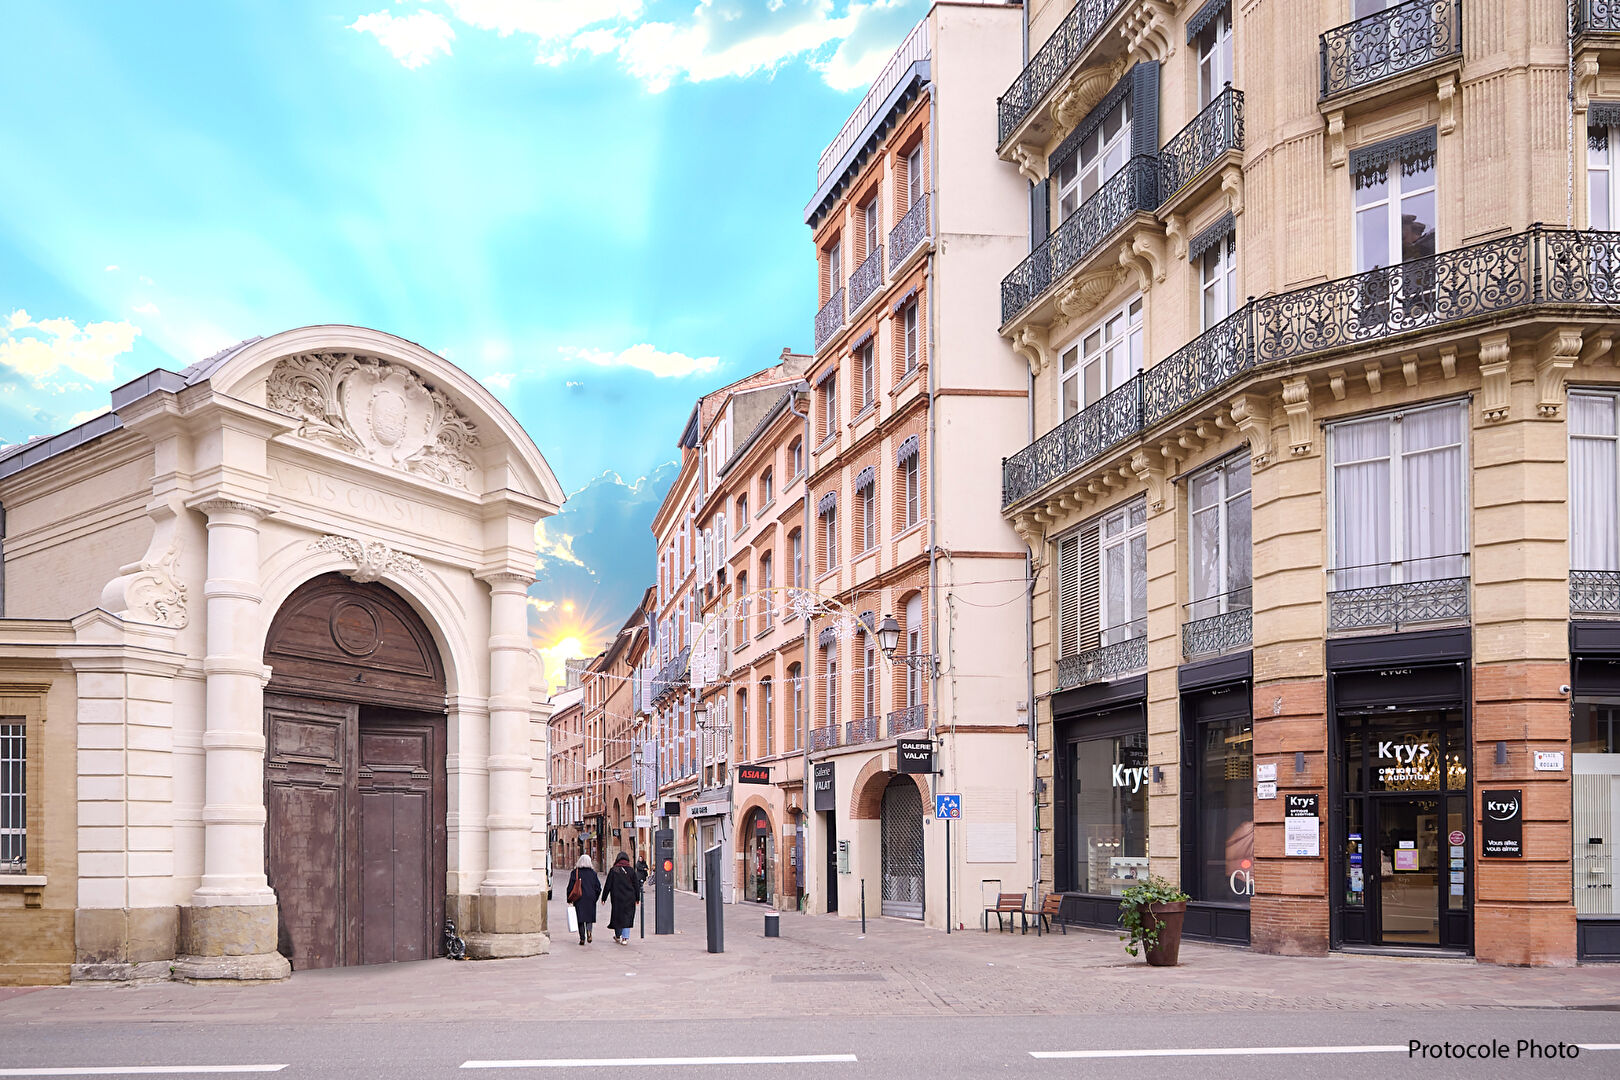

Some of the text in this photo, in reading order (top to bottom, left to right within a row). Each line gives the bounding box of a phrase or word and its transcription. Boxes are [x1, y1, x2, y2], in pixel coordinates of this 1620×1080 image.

[1378, 741, 1430, 763] Krys
[741, 770, 760, 779] ASIA
[815, 767, 831, 777] Galerie
[1112, 763, 1149, 794] Krys
[815, 780, 831, 791] VALAT
[1290, 796, 1315, 808] Krys
[1487, 801, 1515, 813] Krys
